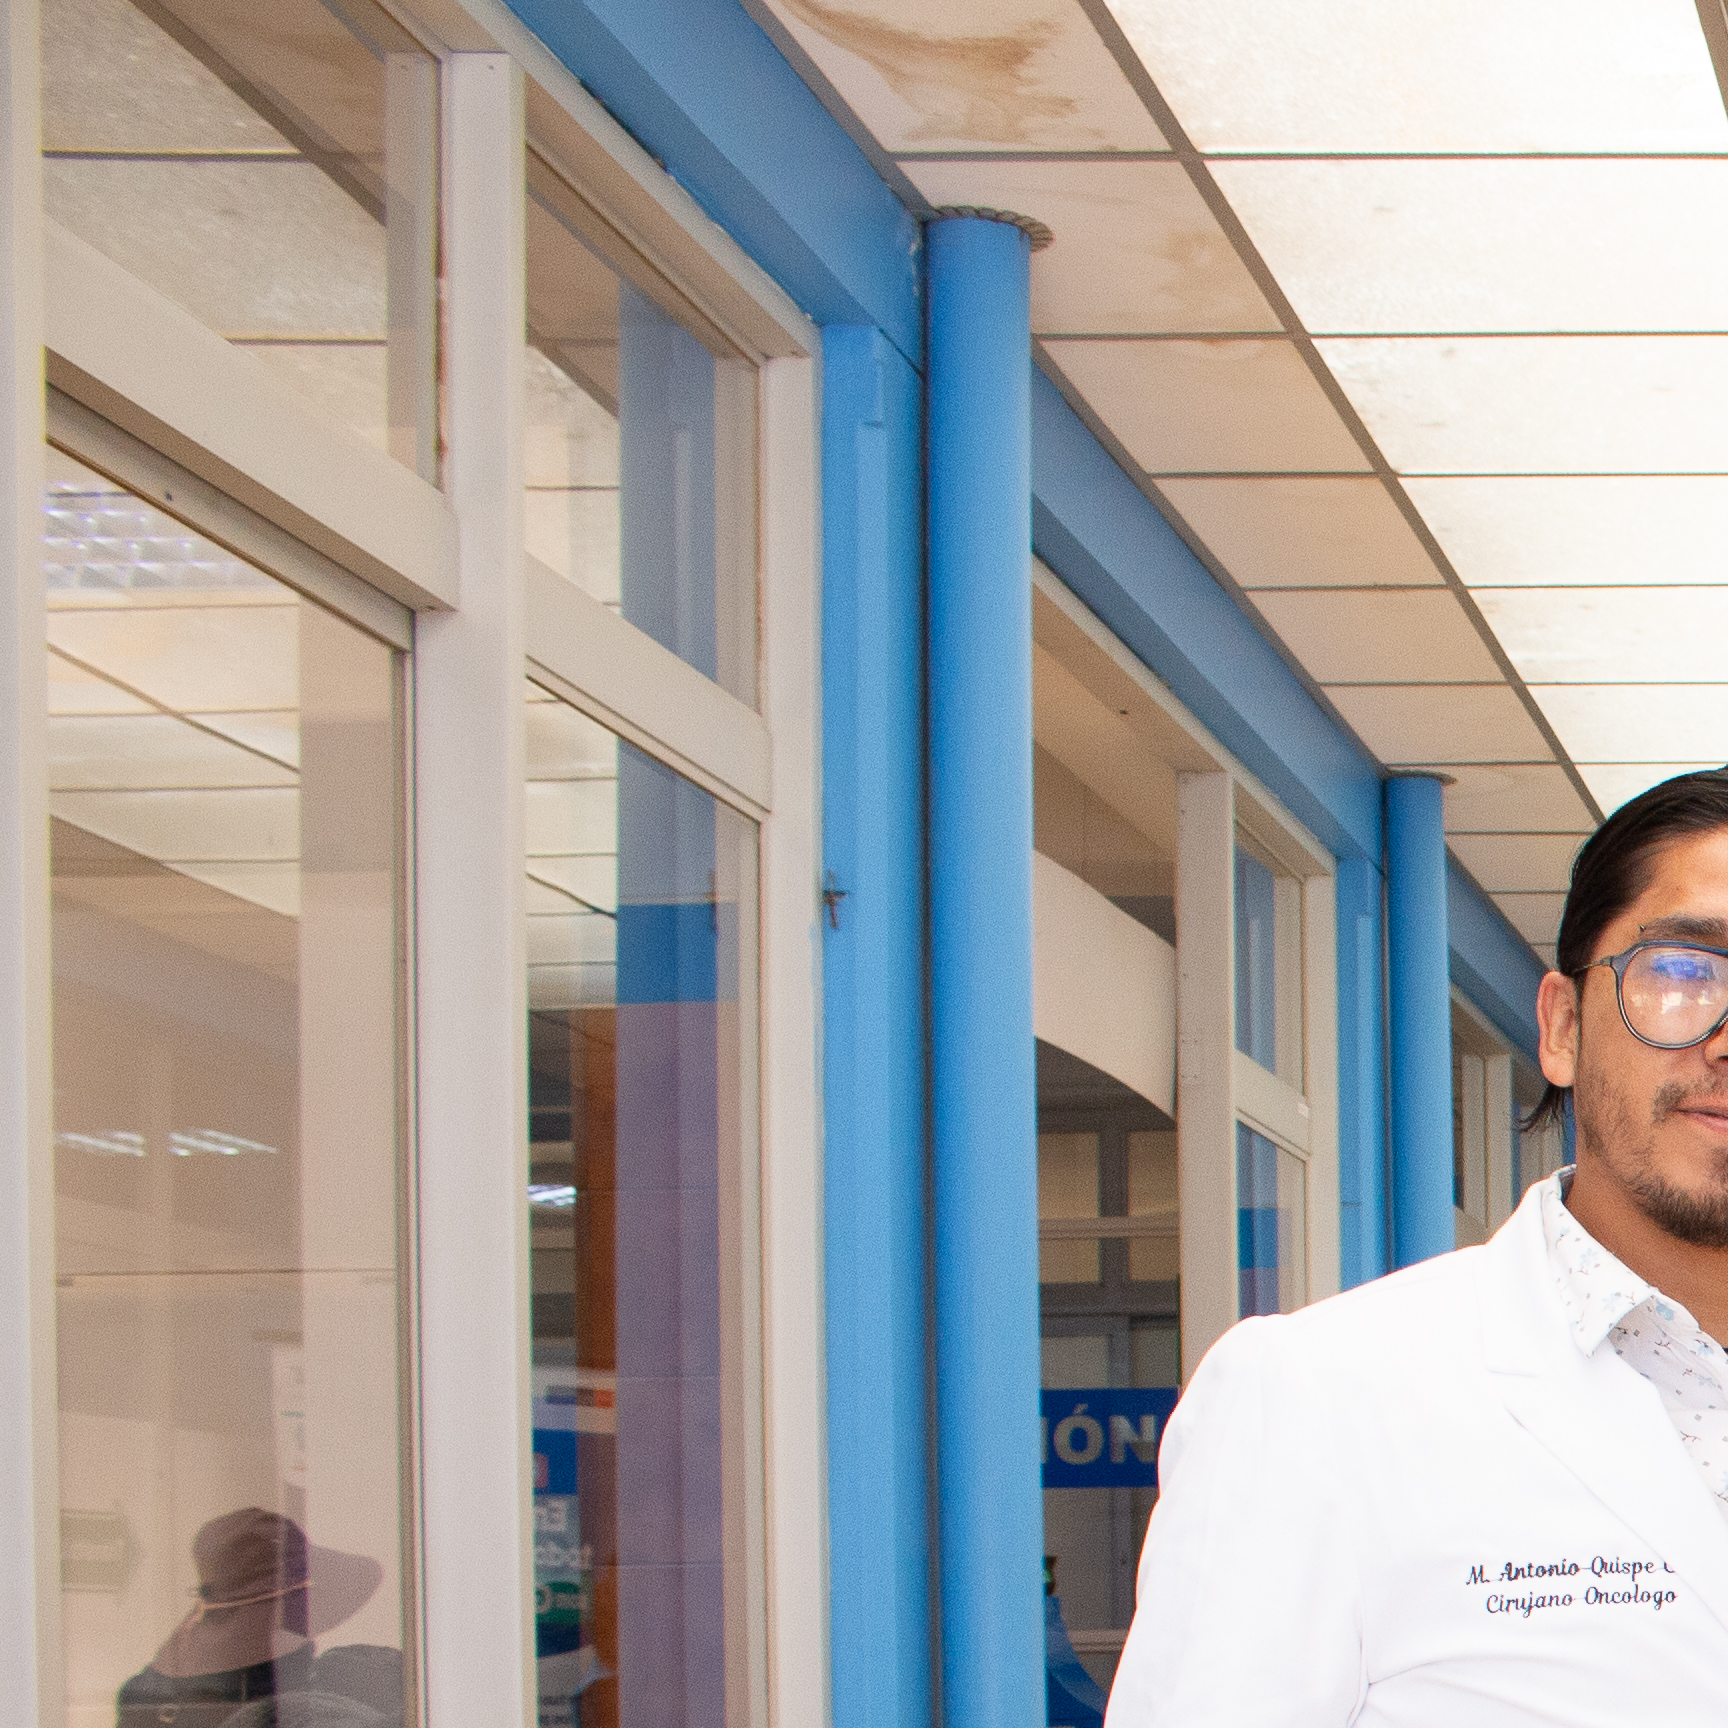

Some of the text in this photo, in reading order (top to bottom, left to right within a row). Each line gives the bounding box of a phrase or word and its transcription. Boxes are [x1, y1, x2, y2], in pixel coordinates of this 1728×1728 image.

[1499, 1558, 1581, 1583] Antonio
[1591, 1555, 1655, 1583] Quispe
[1486, 1583, 1679, 1619] Cirujano Oncologo
